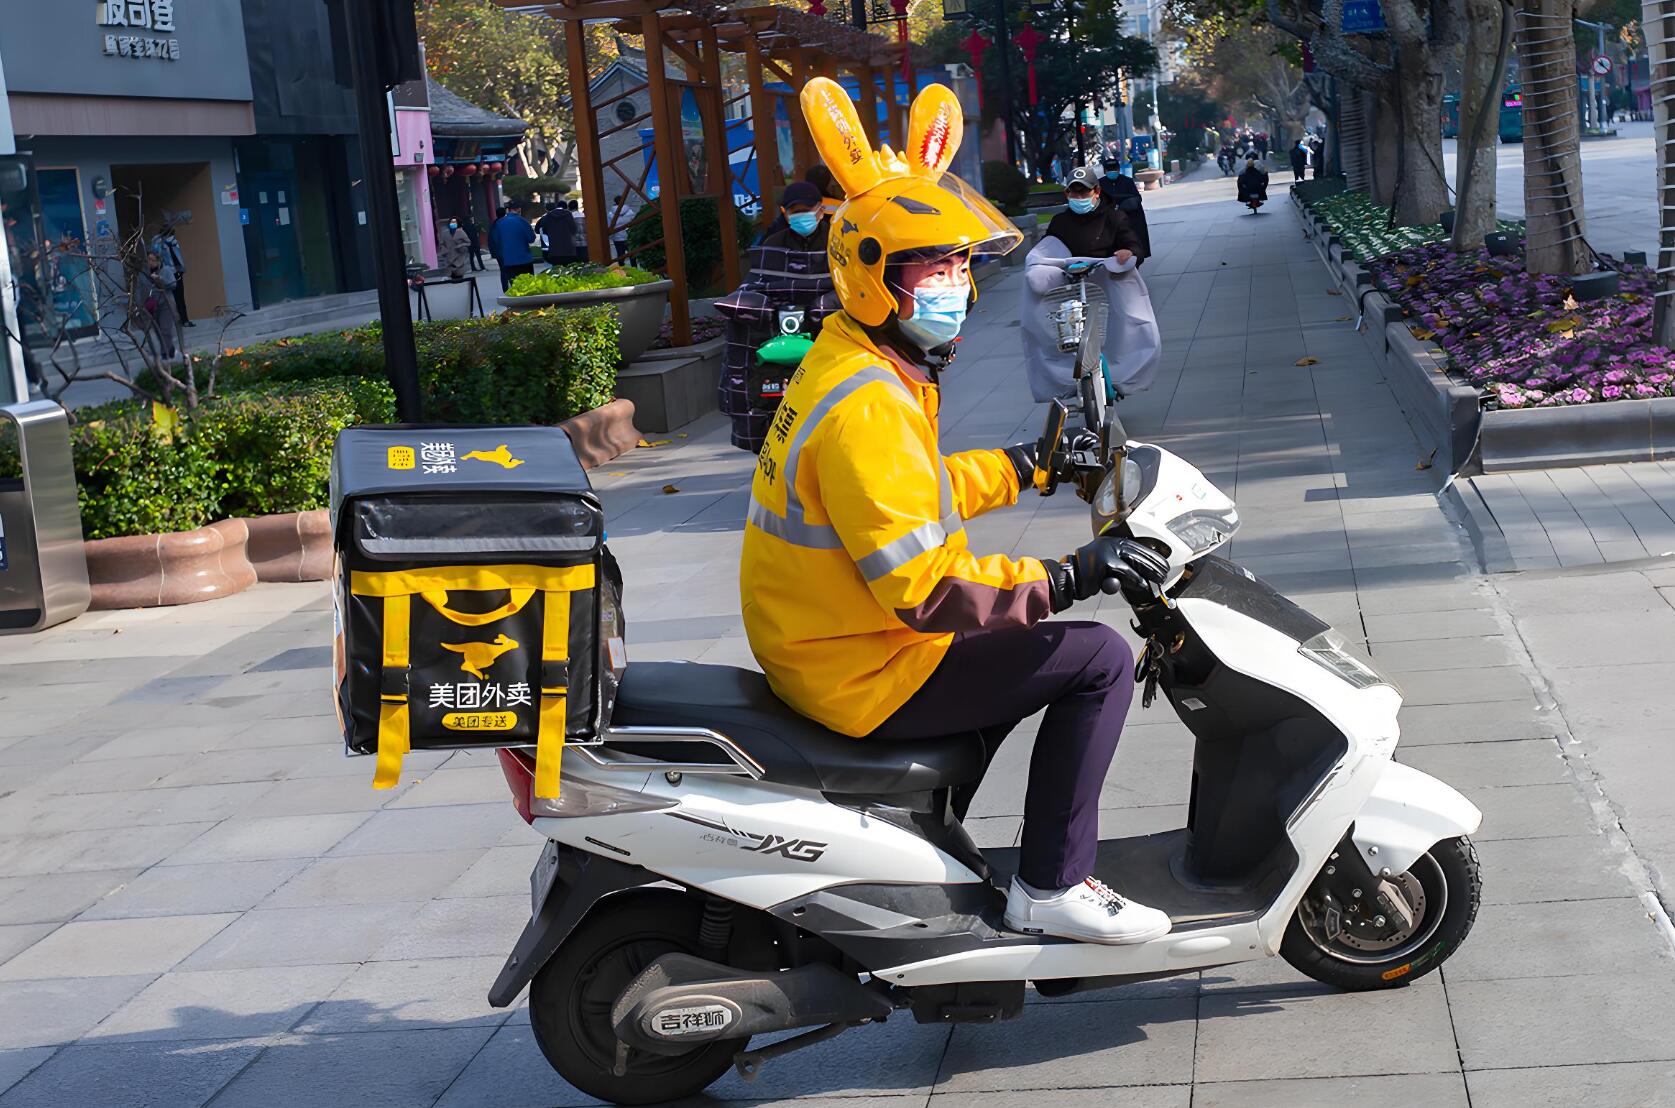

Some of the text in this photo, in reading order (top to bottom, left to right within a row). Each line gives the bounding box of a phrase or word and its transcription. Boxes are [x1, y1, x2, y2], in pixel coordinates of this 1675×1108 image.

[429, 682, 532, 708] 美团外卖
[453, 715, 507, 728] 美团专送
